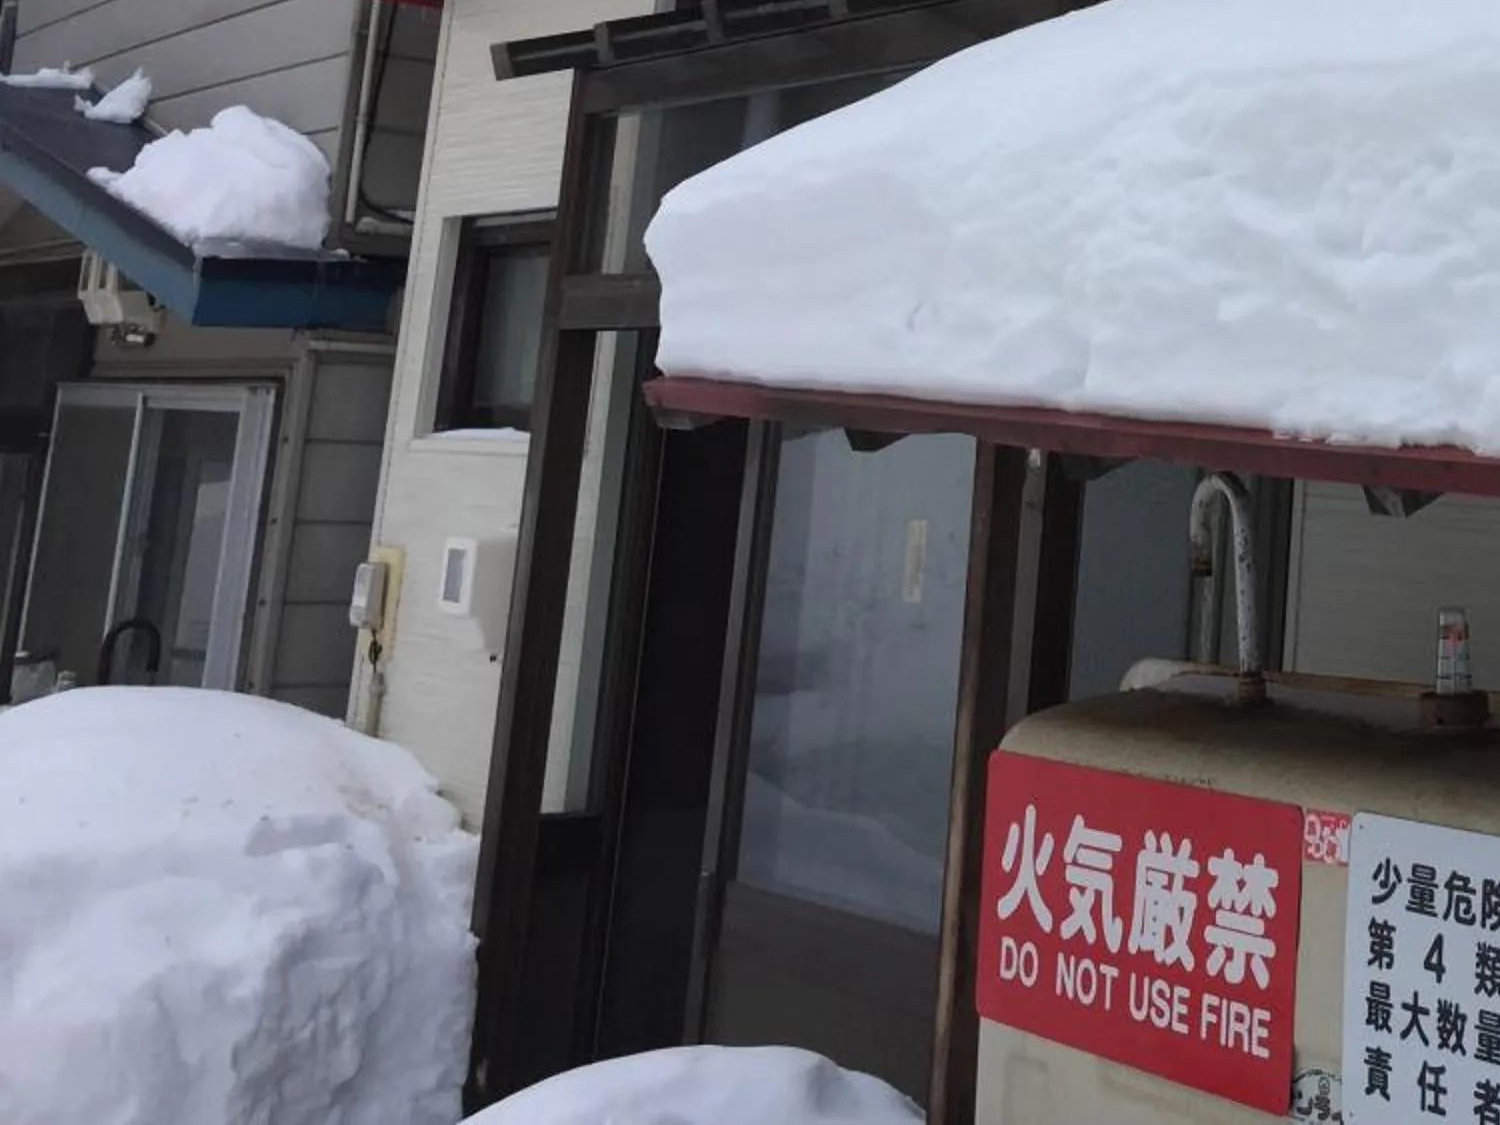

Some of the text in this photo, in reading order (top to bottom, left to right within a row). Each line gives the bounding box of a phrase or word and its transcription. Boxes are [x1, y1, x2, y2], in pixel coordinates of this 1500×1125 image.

[997, 804, 1279, 988] 火気厳禁
[1000, 936, 1271, 1059] DO NOT USE FIRE
